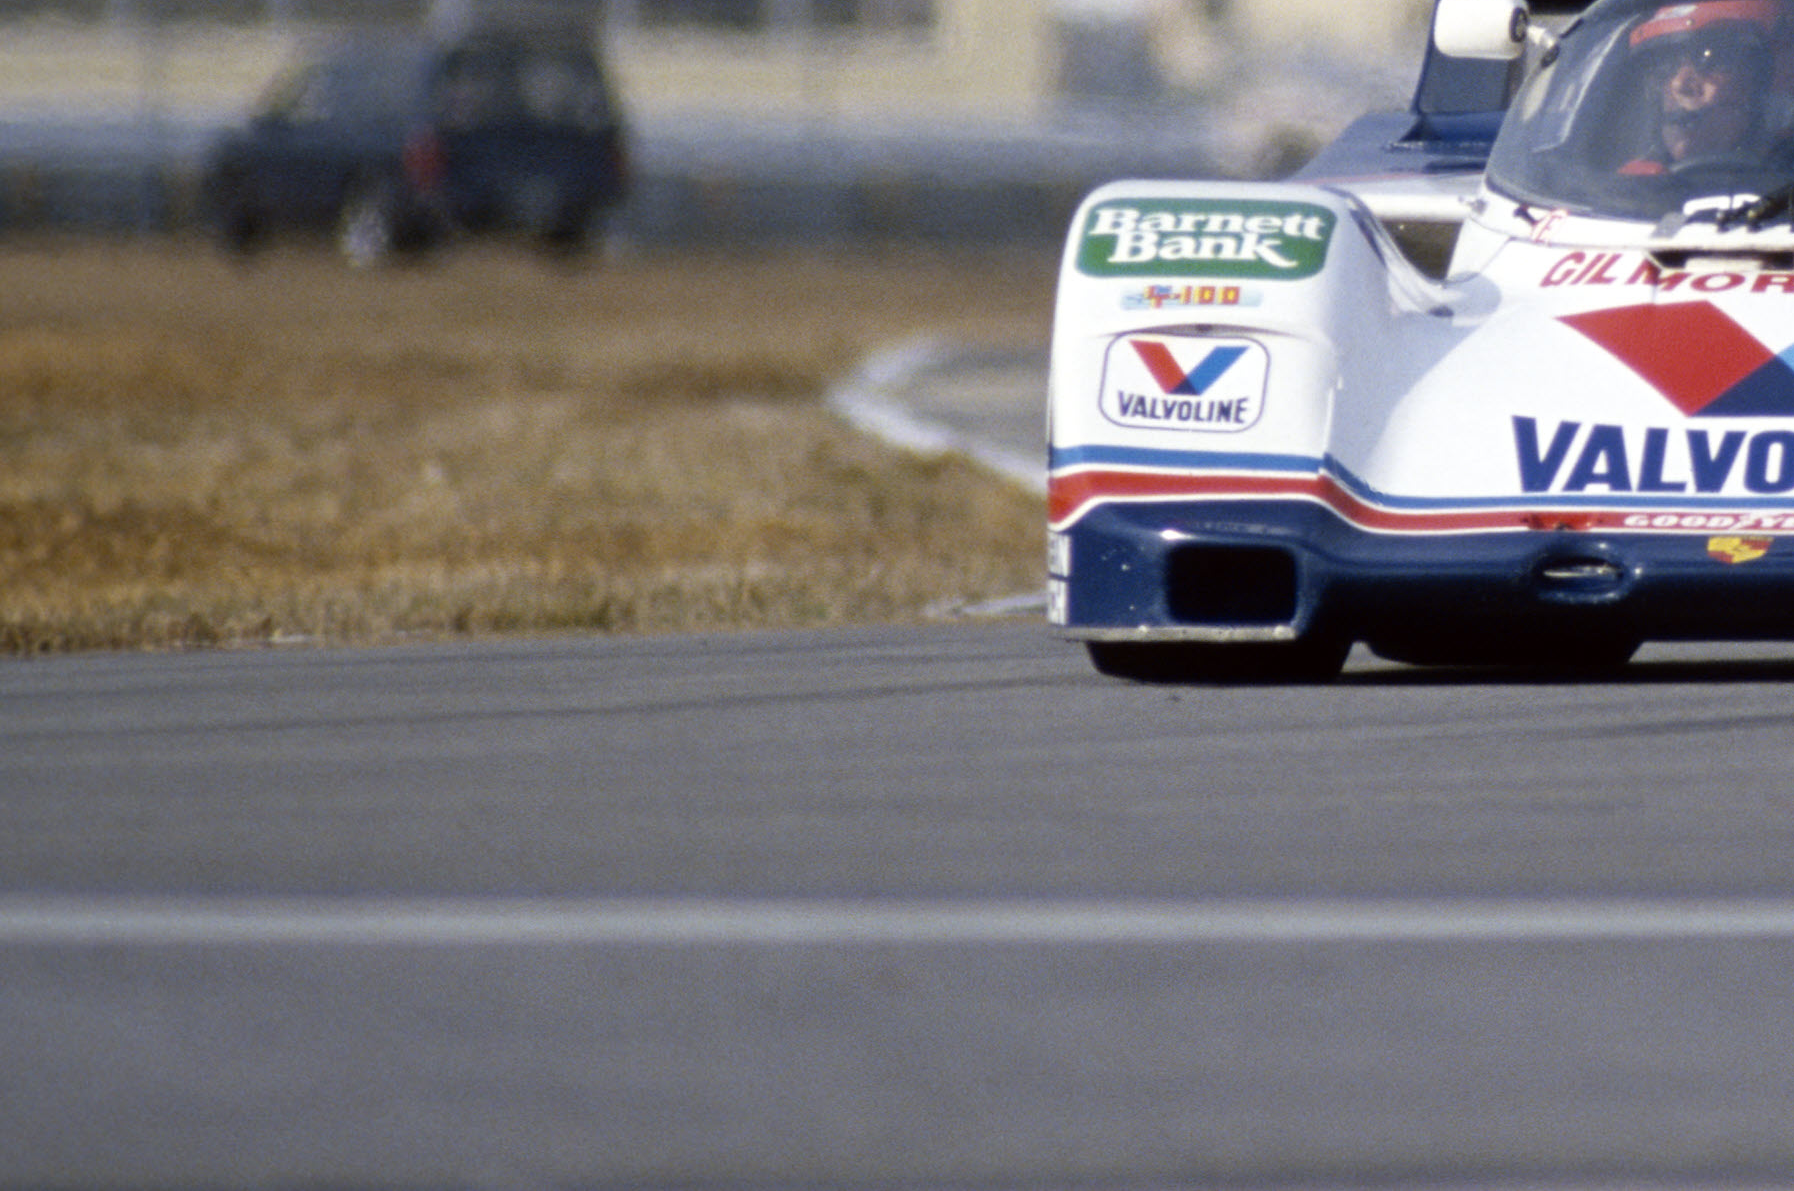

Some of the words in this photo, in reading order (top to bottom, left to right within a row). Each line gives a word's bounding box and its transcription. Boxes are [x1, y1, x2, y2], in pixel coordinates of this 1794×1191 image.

[1088, 207, 1326, 239] Barnett
[1106, 229, 1299, 268] Bank
[1117, 390, 1248, 425] VALVOLINE
